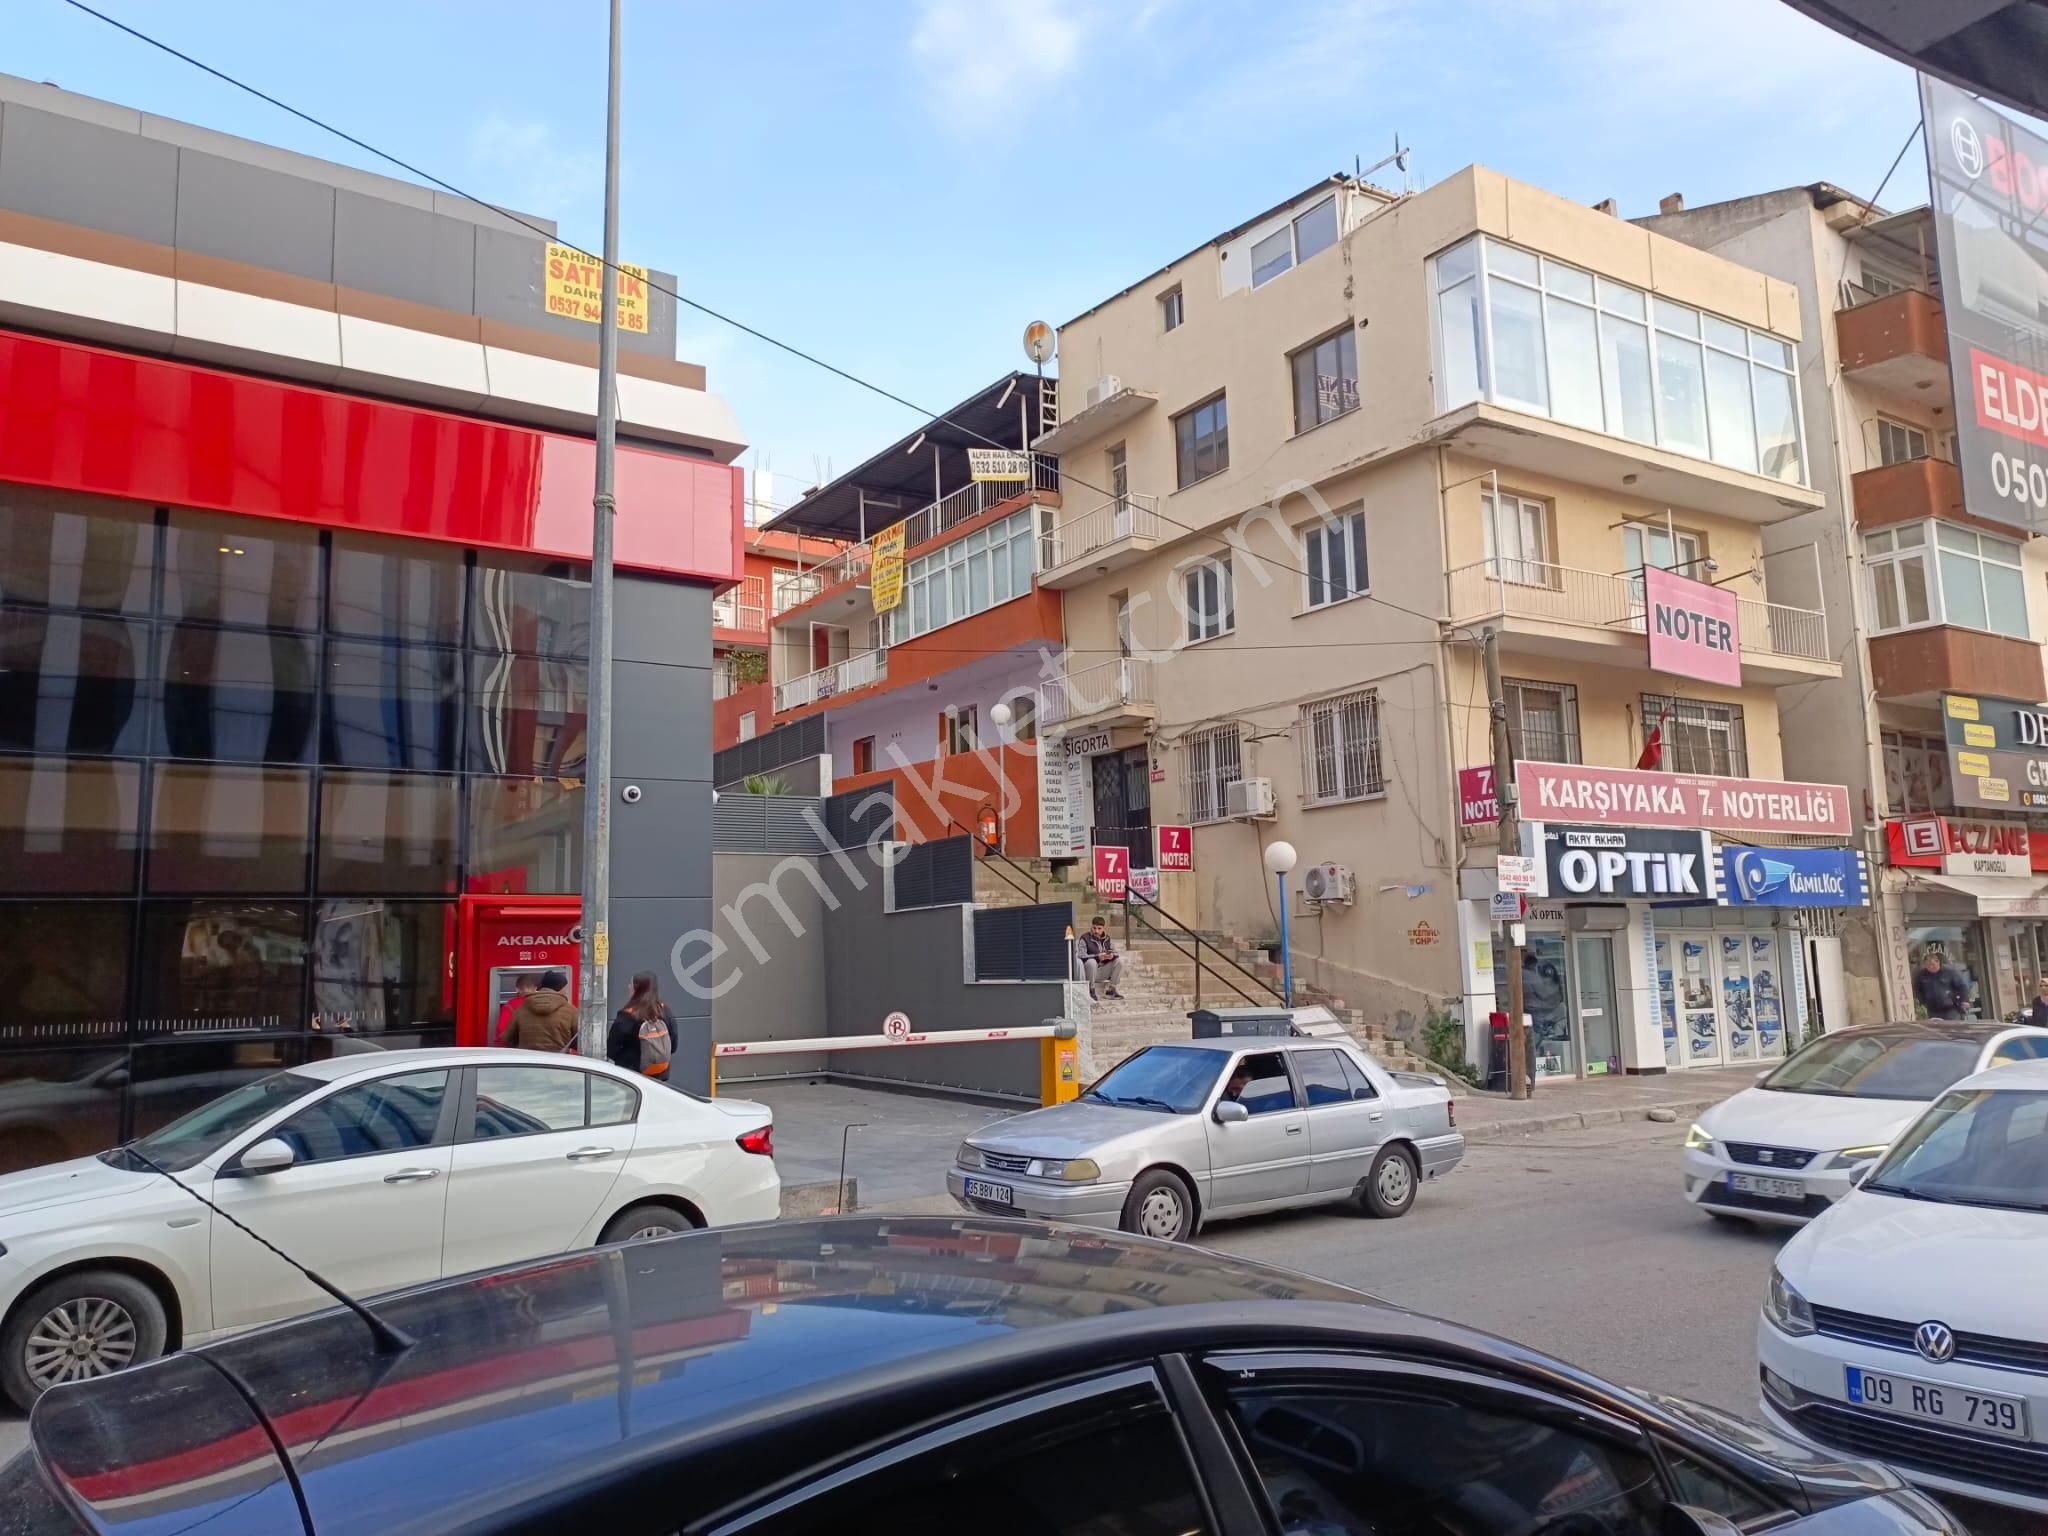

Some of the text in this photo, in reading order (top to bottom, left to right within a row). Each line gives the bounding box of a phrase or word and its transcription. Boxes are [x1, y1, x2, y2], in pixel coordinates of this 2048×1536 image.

[549, 258, 643, 299] SATIIK
[549, 295, 580, 316] 0537
[584, 302, 600, 321] 94
[628, 313, 643, 330] 85
[971, 460, 1029, 474] 0532 510 28 09
[1991, 452, 2048, 509] 050
[1656, 603, 1733, 653] NOTER
[1065, 734, 1110, 758] SİGORTA
[1477, 770, 1493, 795] 7.
[1465, 798, 1499, 820] NOTE
[1538, 777, 1835, 824] KARŞIYAKA 7. NOTERLİĞİ
[1170, 831, 1180, 849] 7.
[1568, 834, 1592, 845] AKAY
[1594, 834, 1625, 846] AKHAN
[1914, 828, 1934, 848] E
[1947, 823, 2029, 857] ECZANE
[1104, 852, 1123, 874] 7.
[1161, 852, 1190, 866] NOTER
[1098, 878, 1126, 893] NOTER
[497, 935, 571, 946] AKBANK
[1892, 926, 1913, 1020] ECZAN
[969, 1181, 978, 1195] 35
[997, 1187, 1009, 1201] 124
[1864, 1375, 1893, 1405] 09
[1912, 1384, 1944, 1416] RG
[1965, 1395, 2016, 1430] 739
